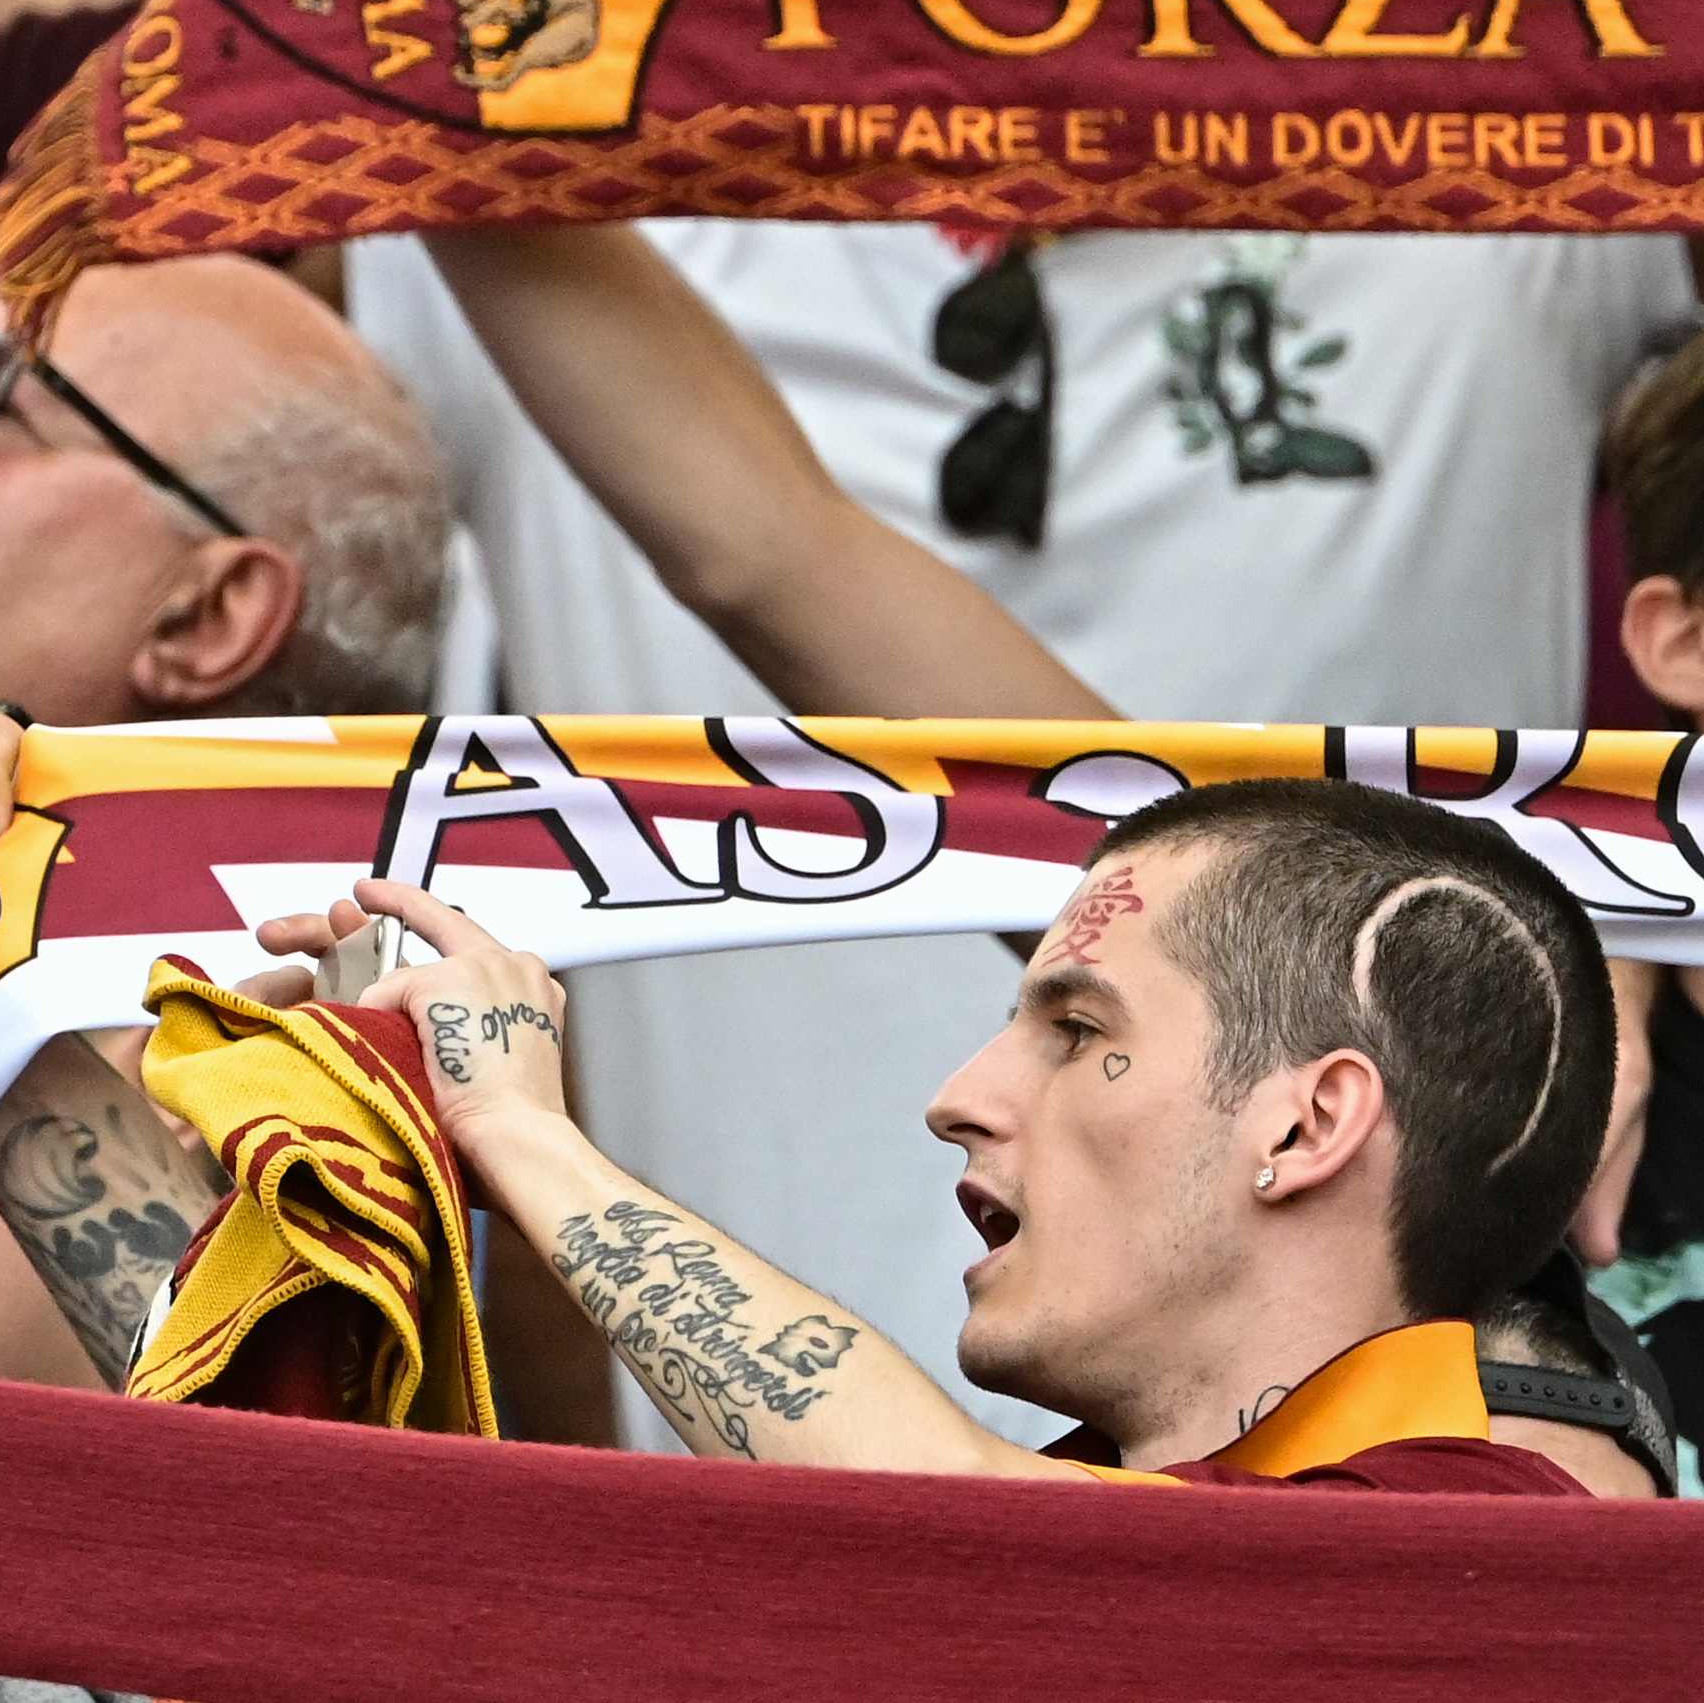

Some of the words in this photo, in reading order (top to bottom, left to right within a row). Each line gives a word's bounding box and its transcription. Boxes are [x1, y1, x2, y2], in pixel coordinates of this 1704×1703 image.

[797, 102, 1041, 162] TIFARE
[1064, 106, 1125, 165] E'
[1153, 110, 1249, 167] UN
[1271, 107, 1568, 168] DOVERE
[1587, 110, 1655, 167] DI
[427, 1001, 473, 1084] Odio
